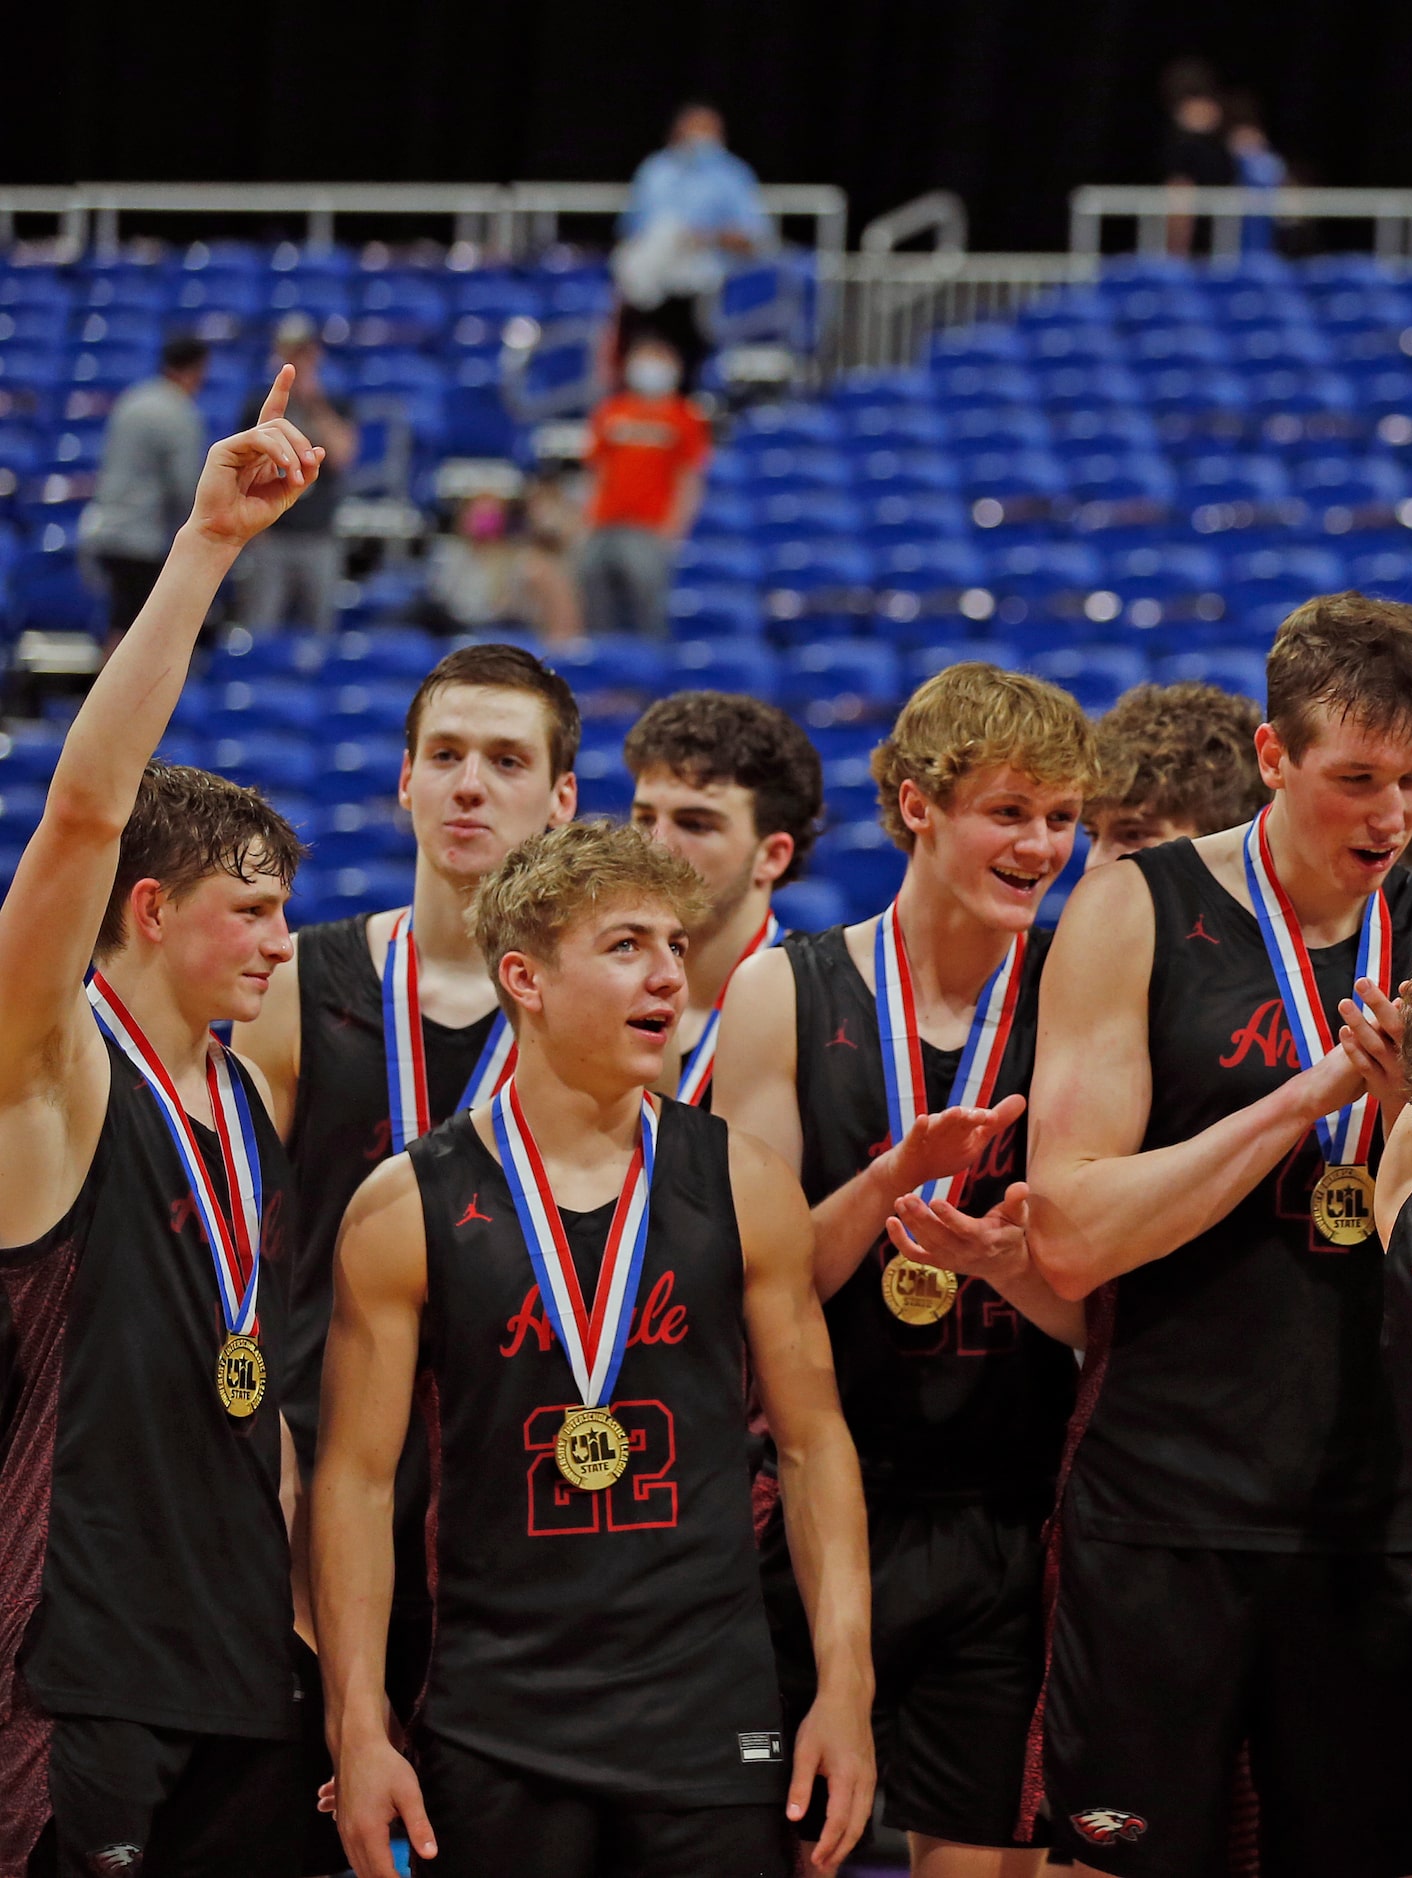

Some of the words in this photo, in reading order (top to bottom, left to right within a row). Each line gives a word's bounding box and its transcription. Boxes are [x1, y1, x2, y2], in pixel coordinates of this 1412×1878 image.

[1334, 1219, 1361, 1228] STATE
[500, 1270, 689, 1358] Ale
[231, 1389, 250, 1400] STATE
[523, 1399, 679, 1536] 22
[580, 1461, 609, 1474] STATE
